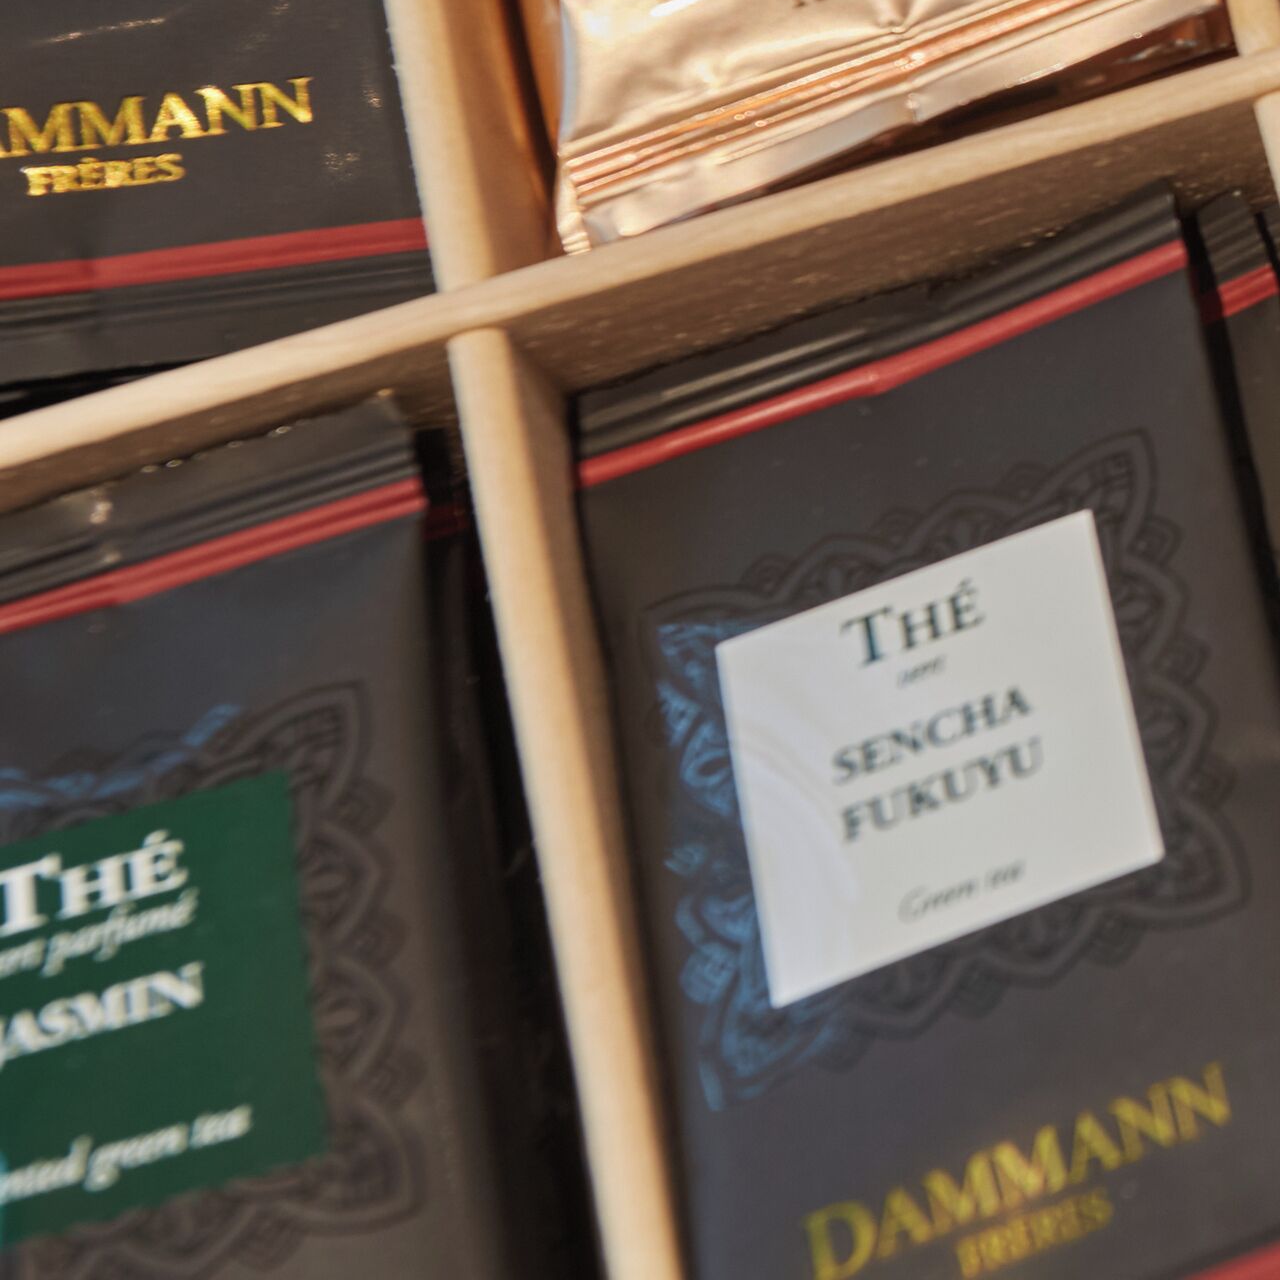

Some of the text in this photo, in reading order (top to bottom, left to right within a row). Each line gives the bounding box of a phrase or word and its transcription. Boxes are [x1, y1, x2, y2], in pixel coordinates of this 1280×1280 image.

[0, 76, 314, 158] MMANN
[20, 153, 186, 197] FRÈRES
[840, 578, 986, 668] THÉ
[830, 686, 1033, 784] SENCHA
[839, 735, 1044, 844] FUKUYU
[0, 829, 189, 937] THÉ
[0, 961, 204, 1067] ASMIN
[803, 1061, 1232, 1280] DAMMANN
